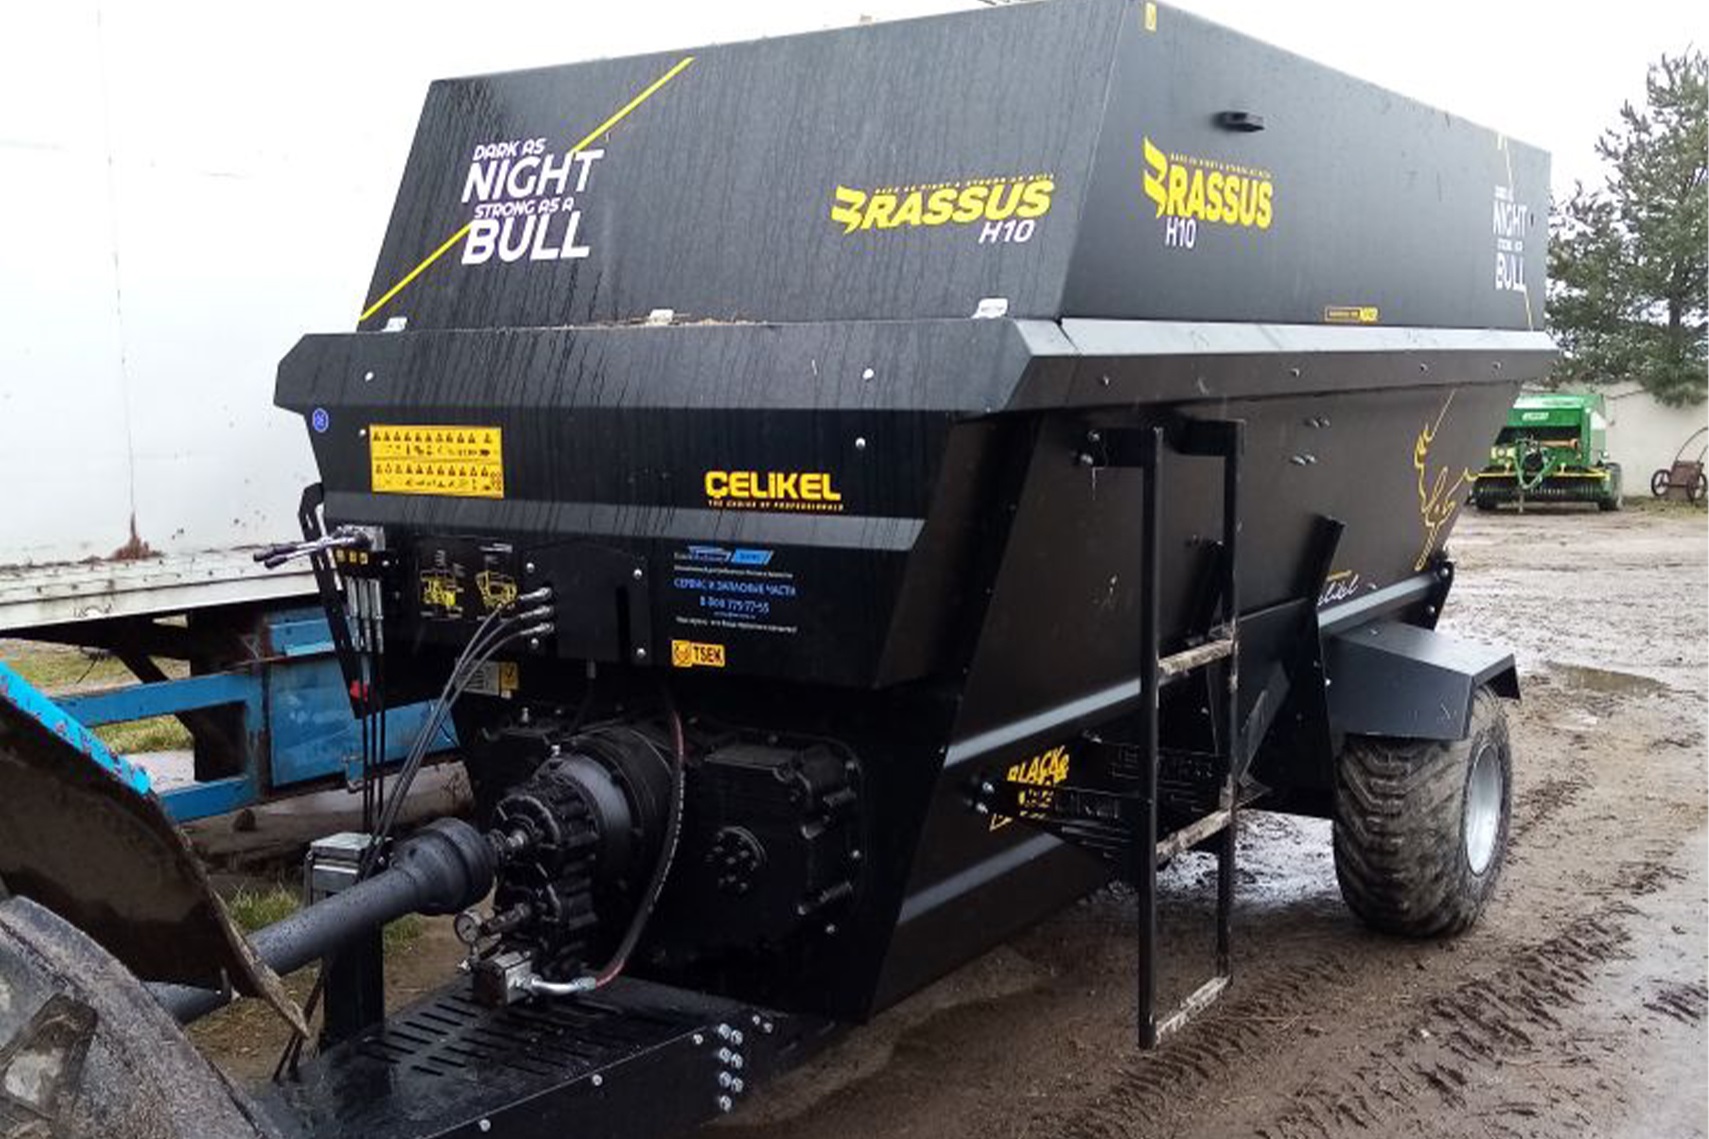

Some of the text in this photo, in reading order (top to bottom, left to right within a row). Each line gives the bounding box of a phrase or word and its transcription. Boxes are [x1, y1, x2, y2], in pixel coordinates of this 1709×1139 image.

[472, 137, 547, 161] DARK AS
[461, 149, 604, 203] NIGHT
[474, 196, 575, 219] STRONG AS A
[1493, 200, 1528, 237] NIGHT
[461, 210, 591, 265] BULL
[978, 219, 1036, 244] H10
[1165, 216, 1197, 249] H10
[1494, 251, 1527, 293] BULL
